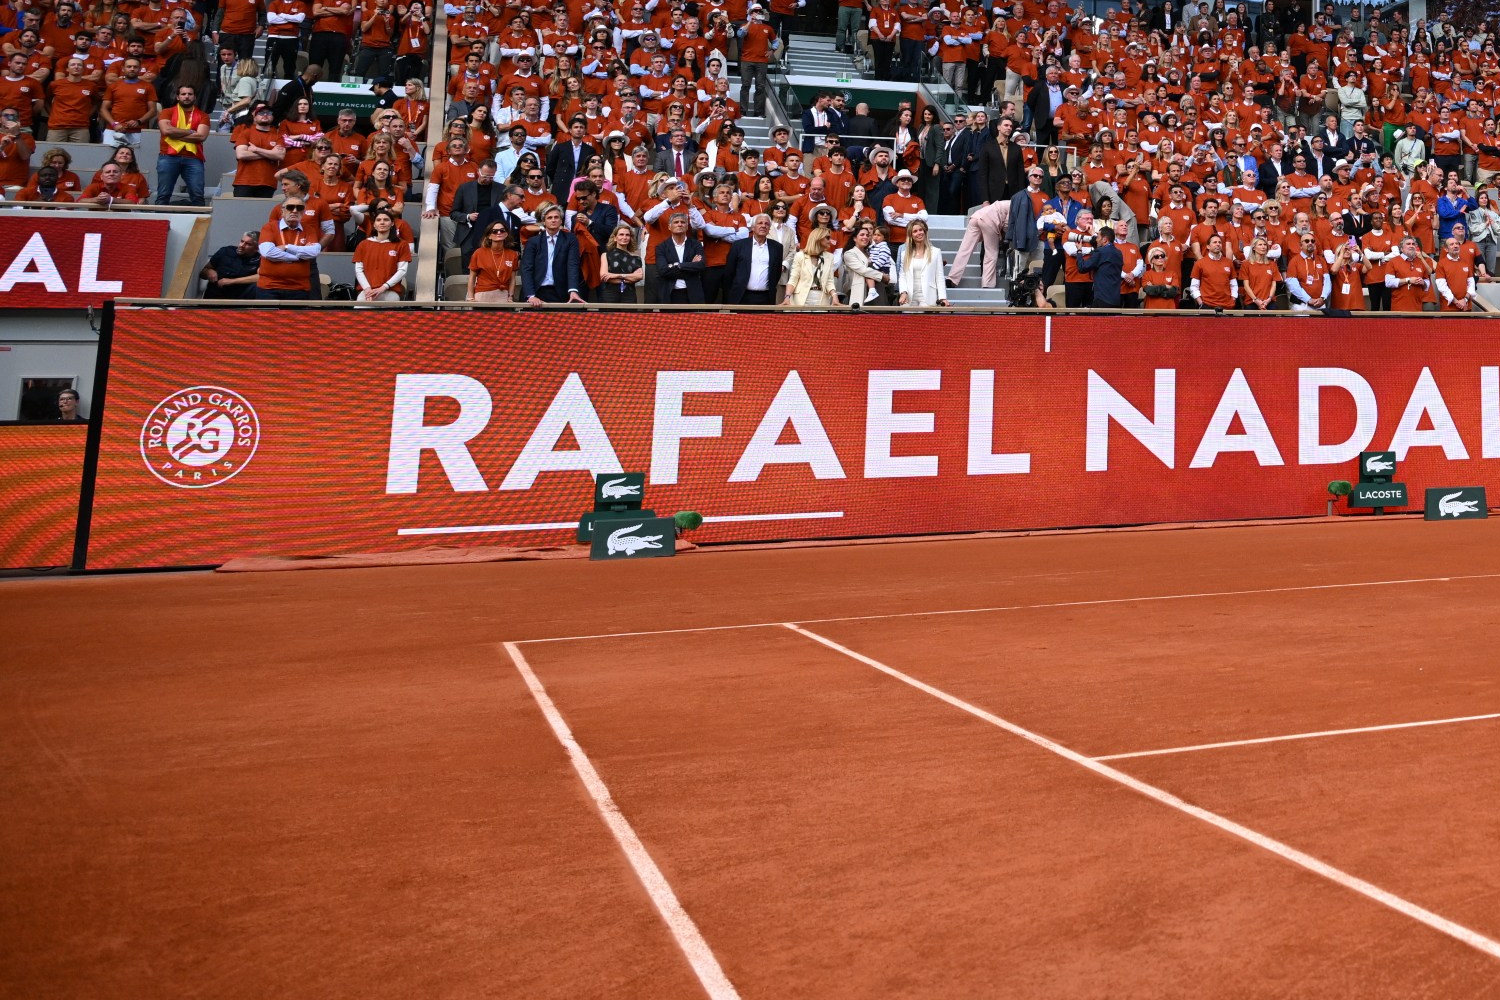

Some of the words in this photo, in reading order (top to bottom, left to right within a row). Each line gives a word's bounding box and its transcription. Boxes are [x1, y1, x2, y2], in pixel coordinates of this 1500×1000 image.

[0, 232, 123, 293] AL
[148, 393, 202, 449] ROLAND
[208, 393, 253, 447] GARROS
[385, 369, 1031, 494] RAFAEL
[161, 461, 233, 480] PARIS
[1359, 490, 1402, 499] LACOSTE
